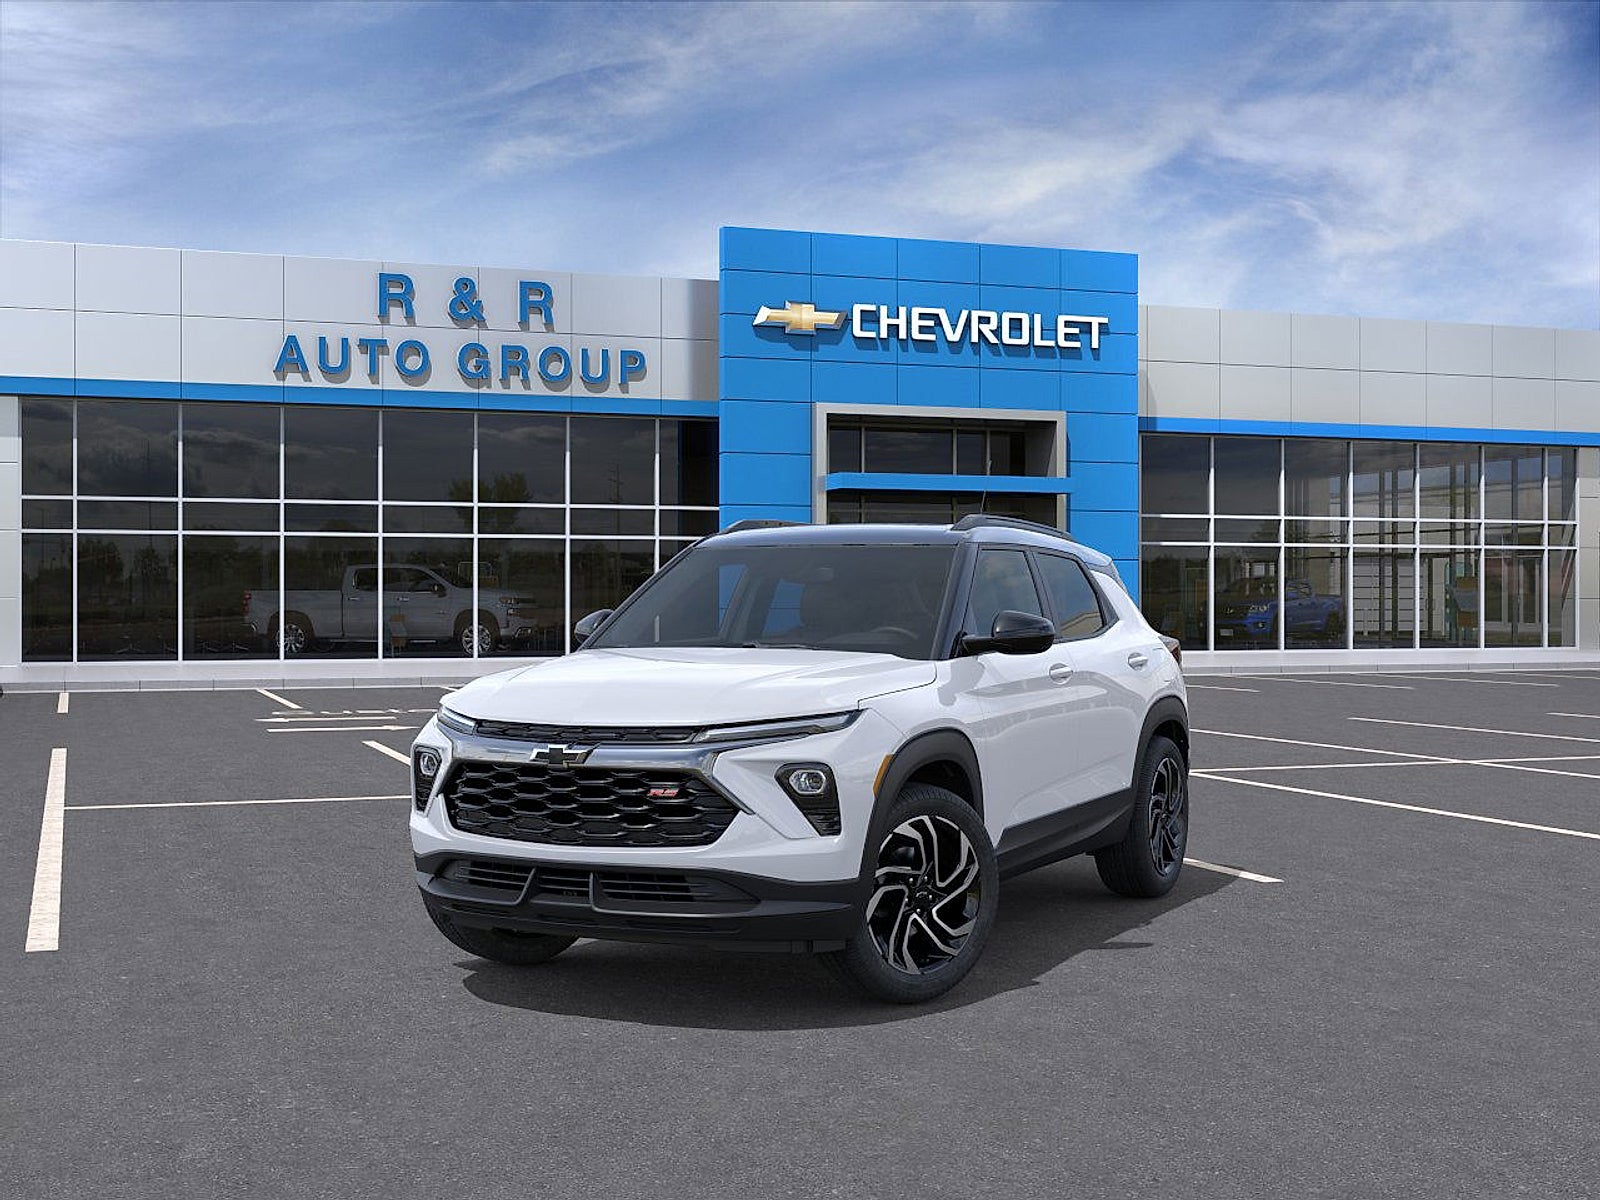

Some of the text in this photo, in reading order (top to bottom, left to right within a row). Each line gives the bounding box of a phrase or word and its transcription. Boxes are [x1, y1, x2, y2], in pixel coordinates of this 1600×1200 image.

[378, 272, 554, 324] R & R
[852, 303, 1109, 349] CHEVROLET
[275, 335, 647, 385] AUTO GROUP
